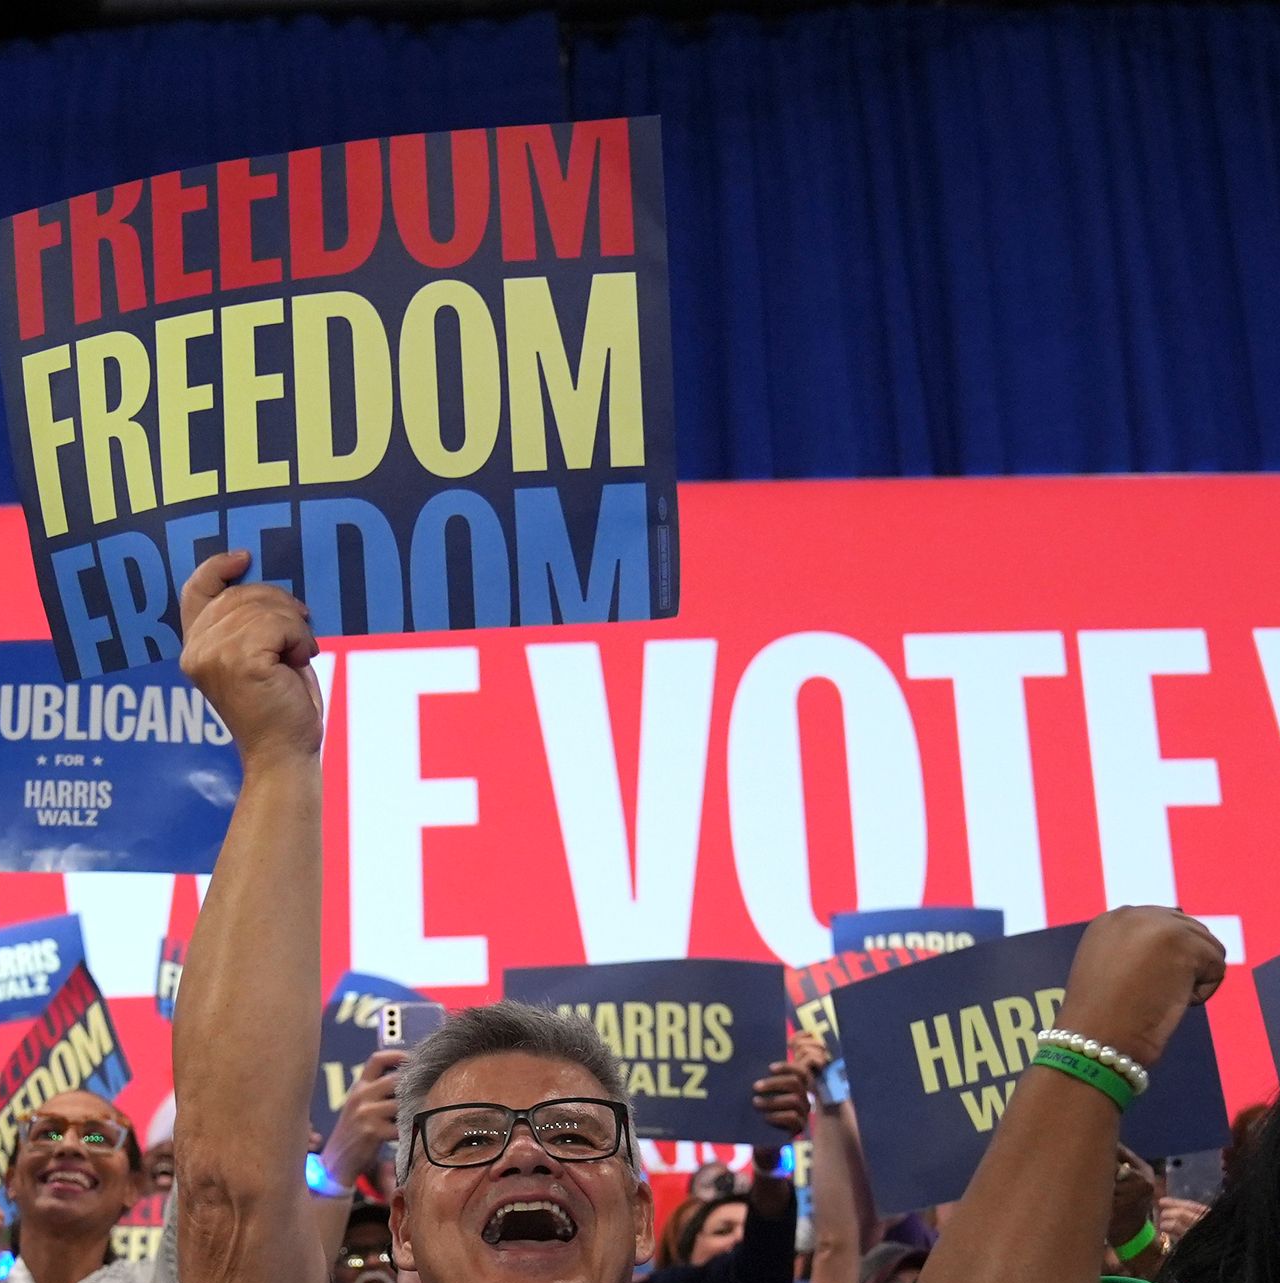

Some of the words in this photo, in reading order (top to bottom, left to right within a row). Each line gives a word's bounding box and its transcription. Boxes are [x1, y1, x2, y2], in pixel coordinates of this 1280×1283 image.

[12, 117, 636, 341] FREEDOM
[22, 272, 646, 538] FREEDOM
[54, 754, 86, 767] FOR
[24, 779, 113, 810] HARRIS
[36, 809, 99, 828] WALZ
[525, 626, 1246, 990] VOTE
[557, 1002, 734, 1063] ARRIS
[619, 1063, 708, 1099] ALZ
